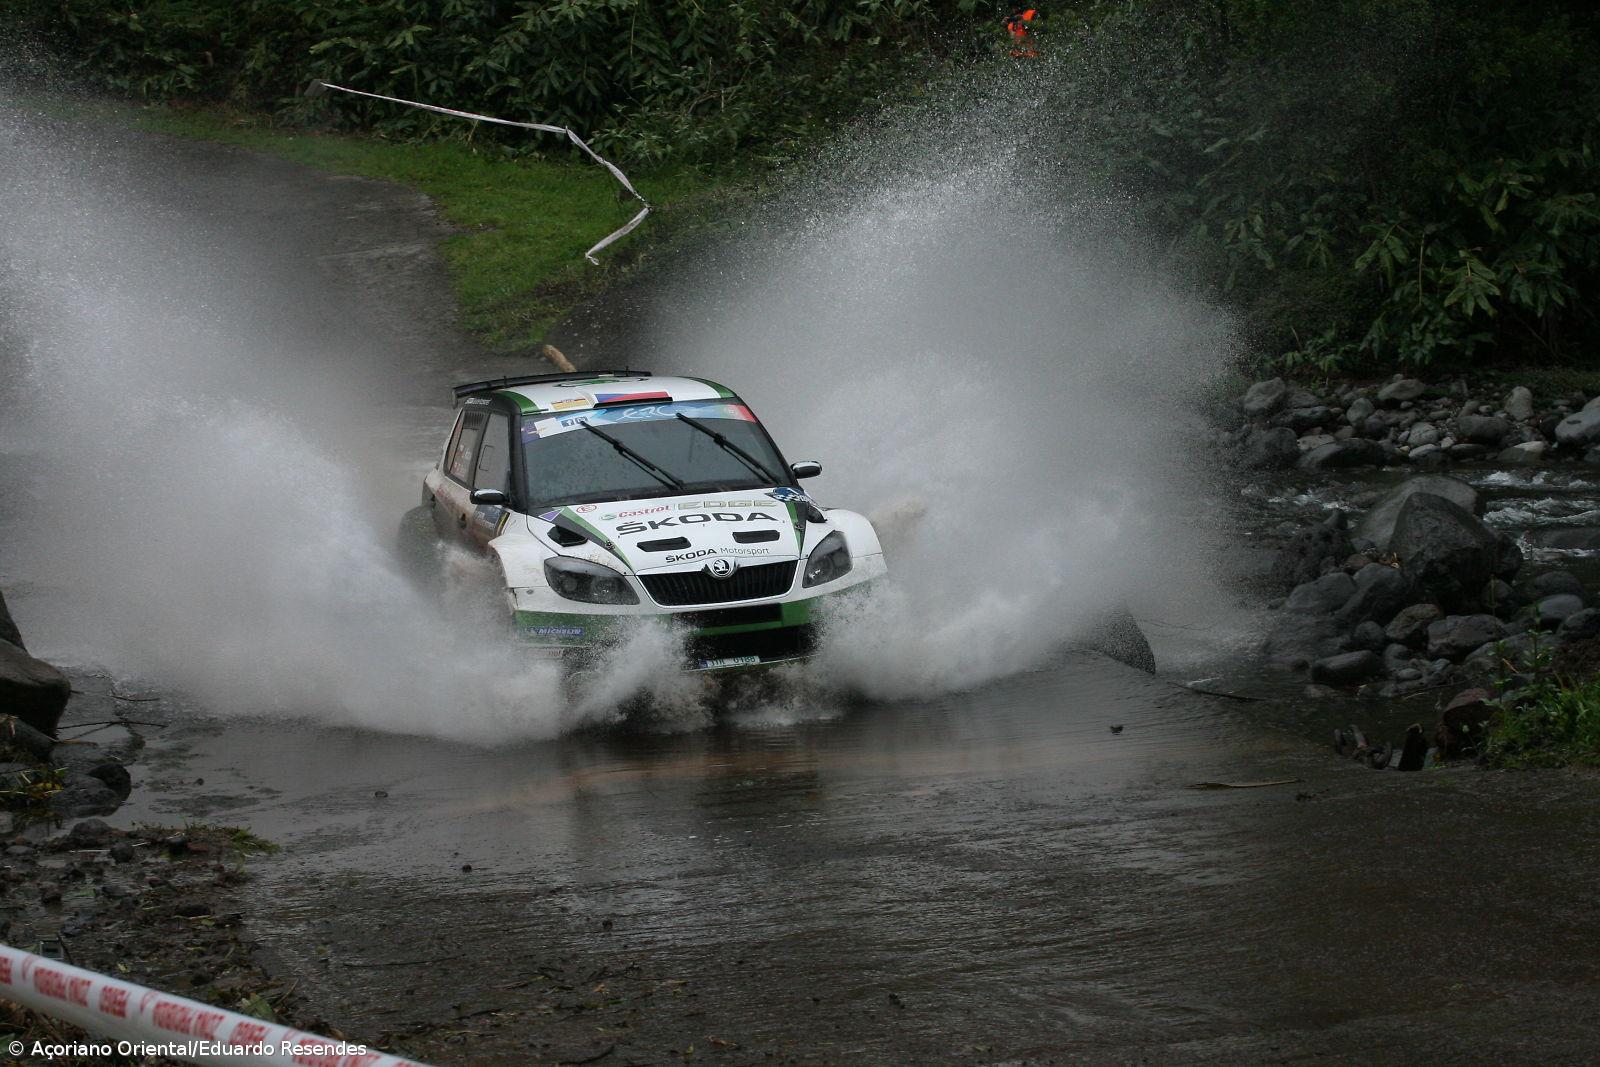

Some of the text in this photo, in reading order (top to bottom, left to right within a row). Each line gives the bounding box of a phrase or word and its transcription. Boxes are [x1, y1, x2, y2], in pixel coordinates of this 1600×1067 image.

[618, 500, 777, 518] Castrol EDGE
[615, 512, 779, 536] ŠKODA
[665, 547, 770, 563] ŠKODA Motorsport
